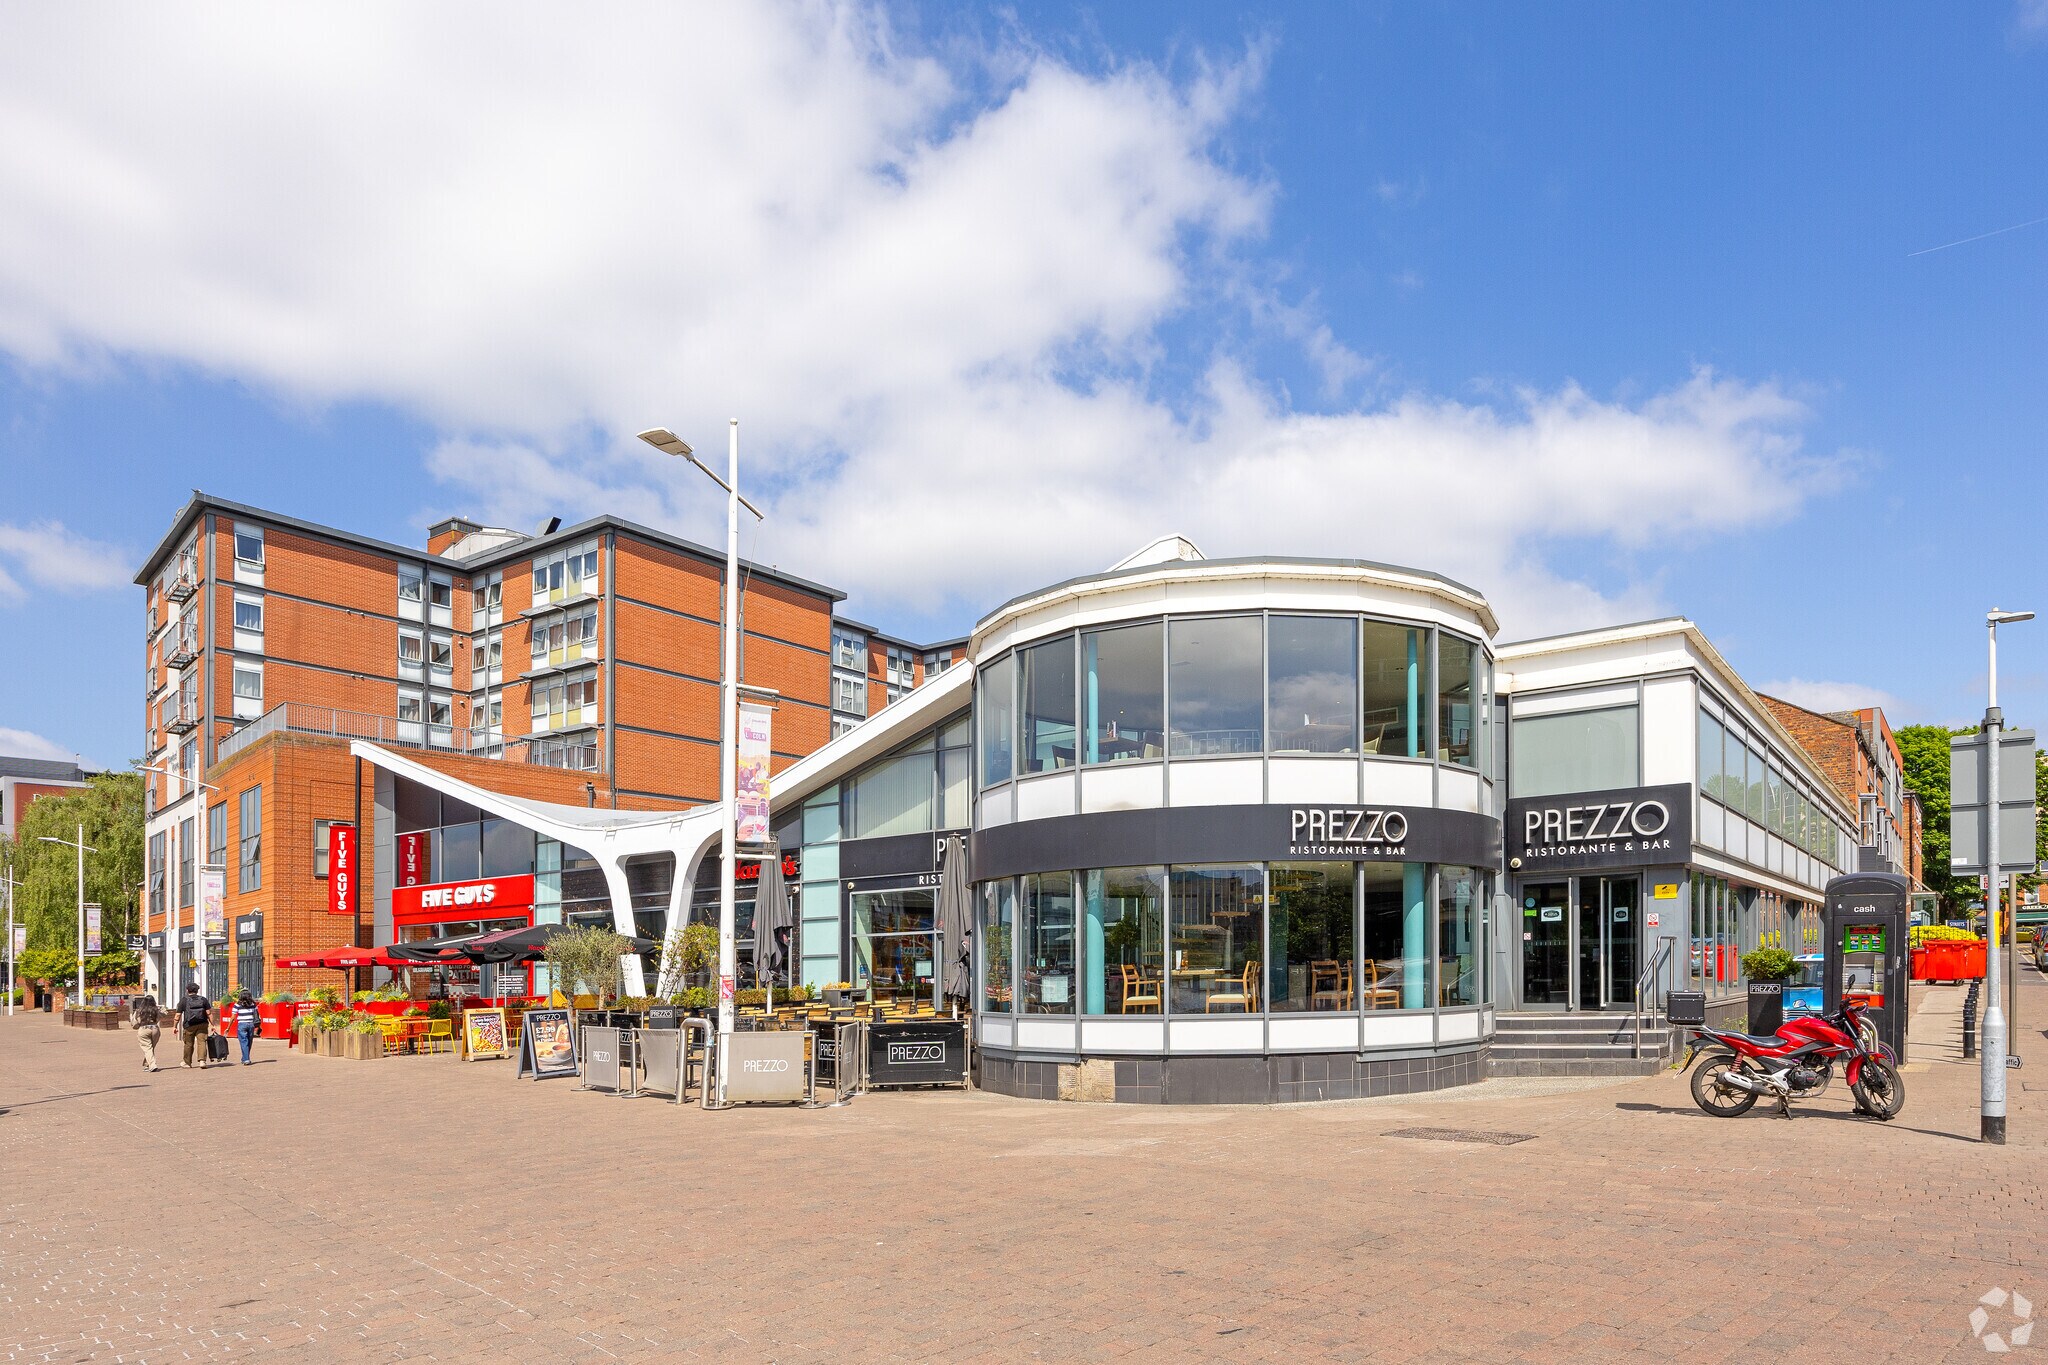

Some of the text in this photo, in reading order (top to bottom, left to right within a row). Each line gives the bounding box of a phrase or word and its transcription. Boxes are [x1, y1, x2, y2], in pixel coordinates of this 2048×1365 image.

[1291, 809, 1408, 843] PREZZO
[1525, 800, 1670, 844] PREZZO
[1290, 846, 1406, 855] RISTORANTE & BAR
[1526, 839, 1671, 857] RISTORANTE & BAR
[337, 832, 347, 910] FIVE GUYS
[421, 884, 496, 908] FIVE GUYS
[1853, 904, 1876, 913] cash
[1751, 985, 1779, 993] PREZZO
[536, 1013, 561, 1022] PREZZO
[650, 1010, 673, 1018] PREZZO
[891, 1046, 942, 1060] PREZZO
[743, 1060, 789, 1072] PREZZO
